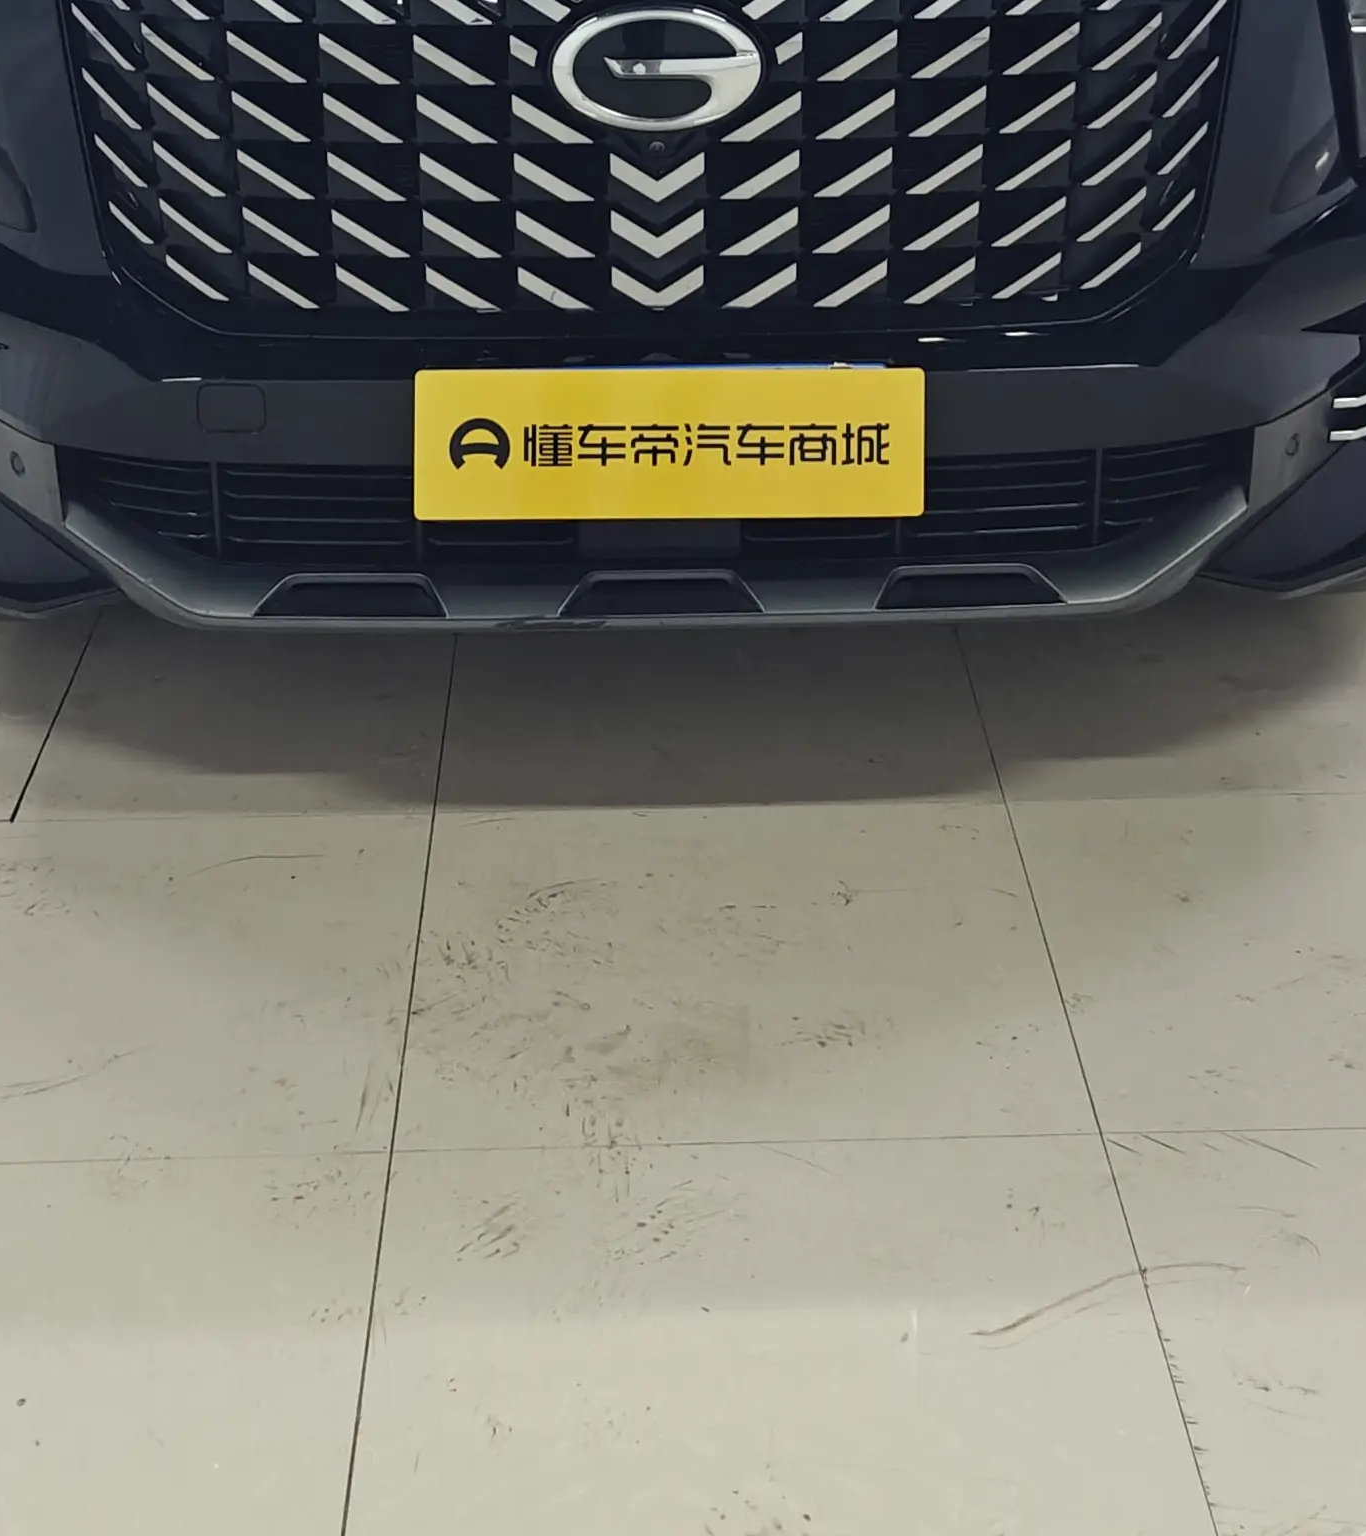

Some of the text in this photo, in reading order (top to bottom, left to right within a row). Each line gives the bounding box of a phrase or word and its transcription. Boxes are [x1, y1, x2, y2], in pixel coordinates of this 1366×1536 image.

[523, 422, 890, 467] 懂车帝汽车商城
